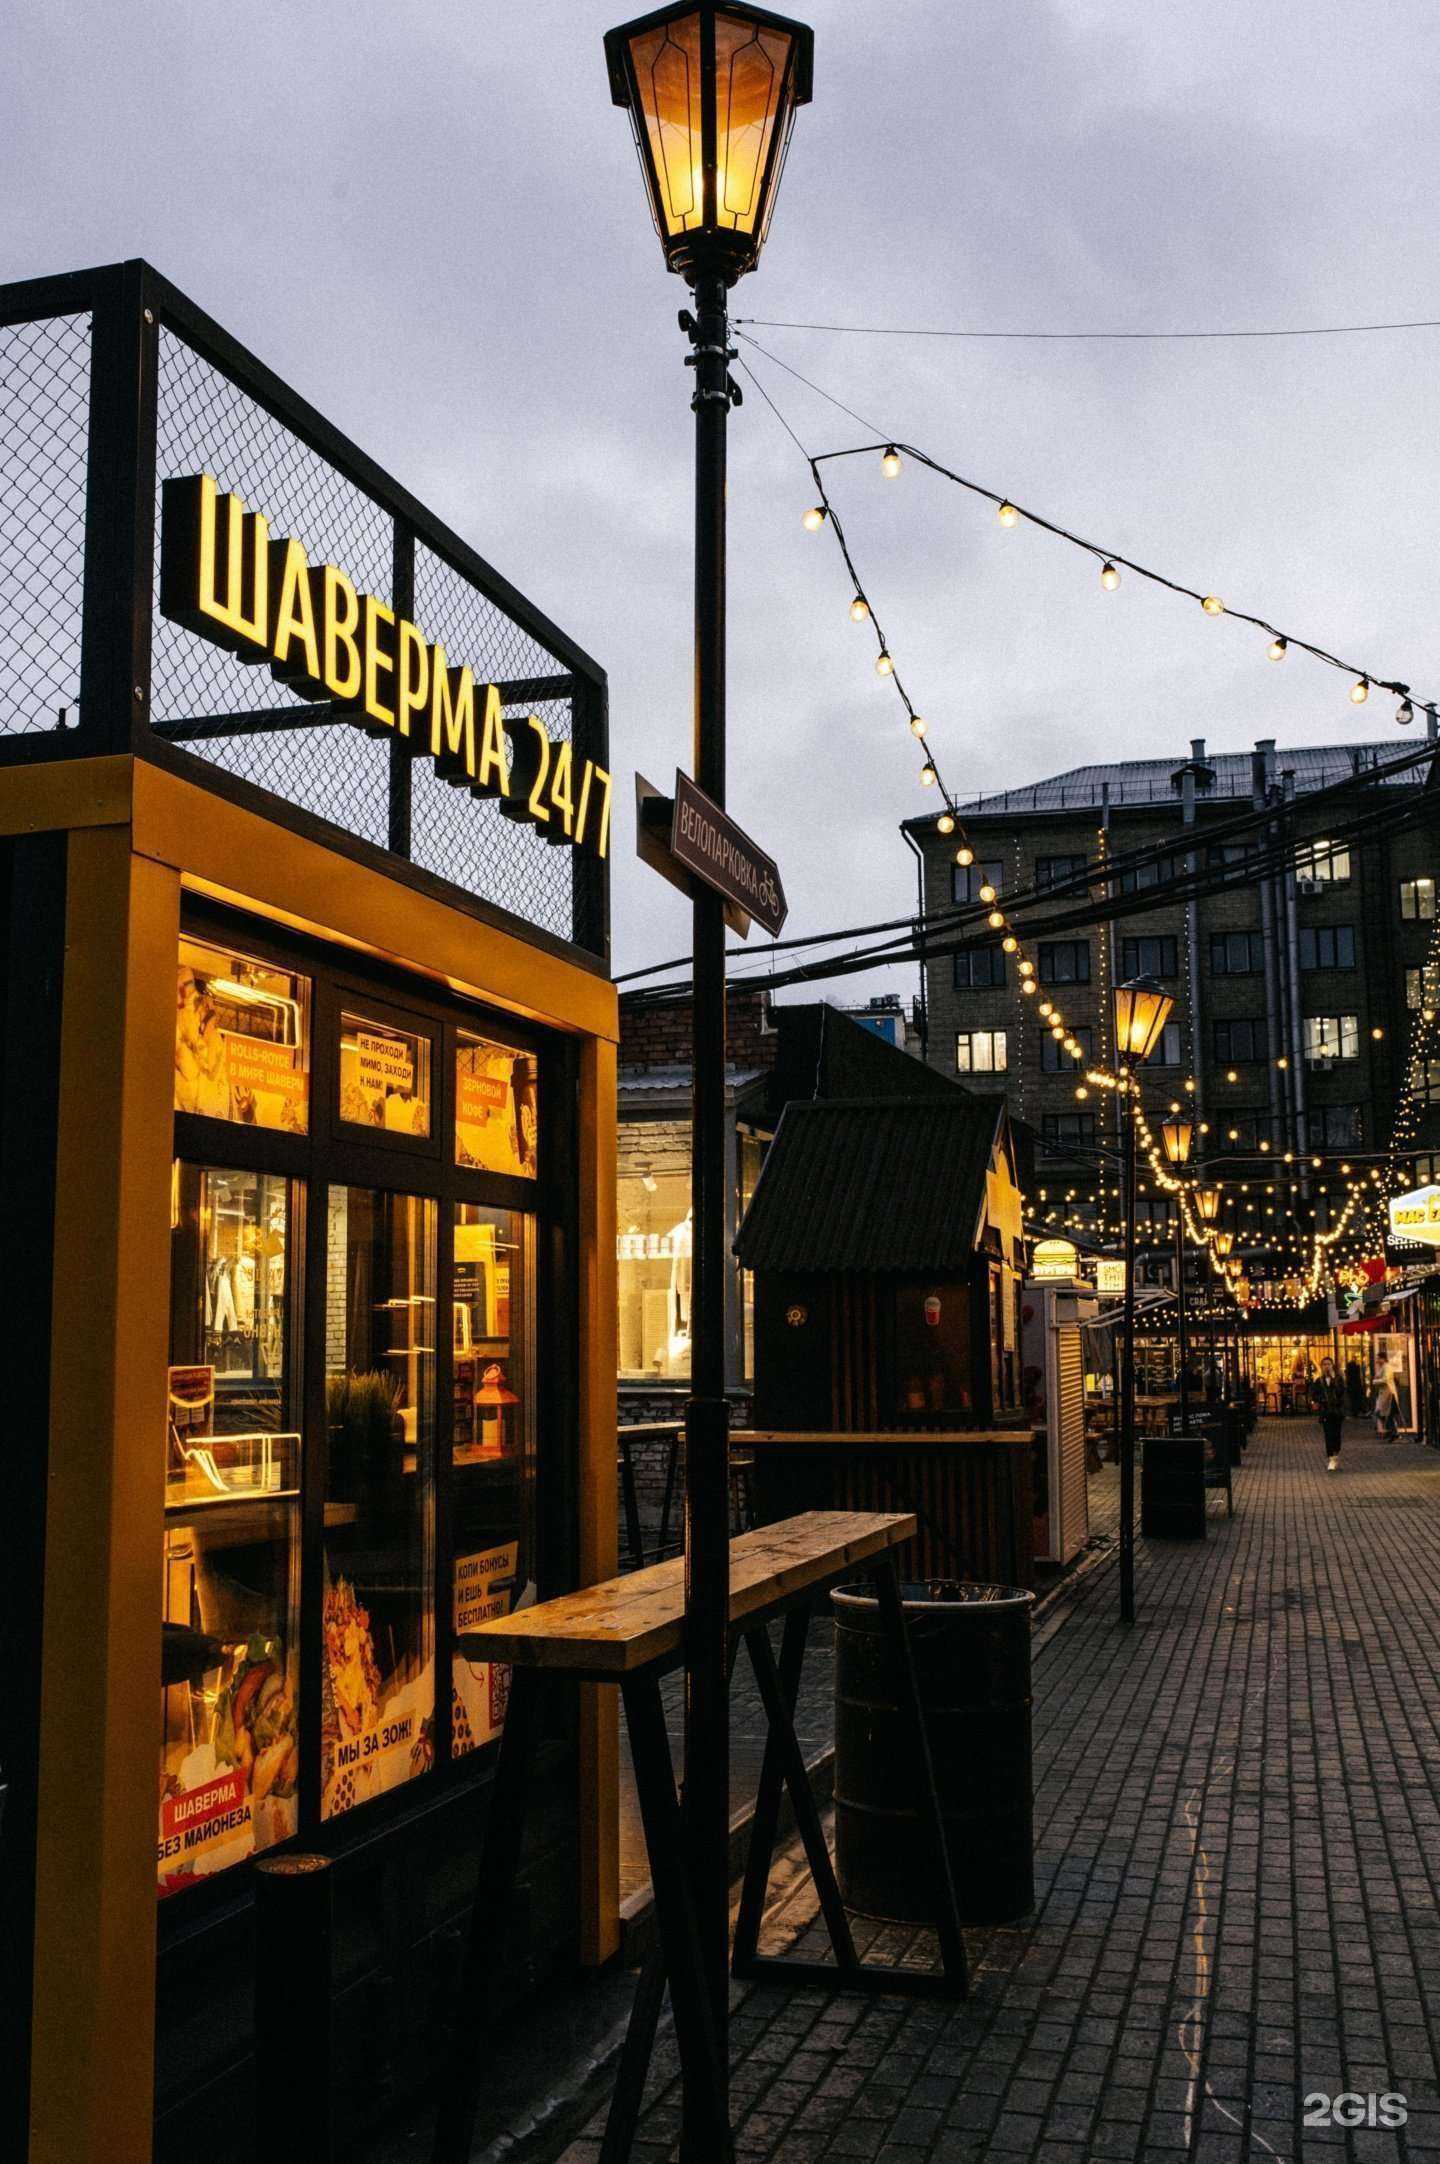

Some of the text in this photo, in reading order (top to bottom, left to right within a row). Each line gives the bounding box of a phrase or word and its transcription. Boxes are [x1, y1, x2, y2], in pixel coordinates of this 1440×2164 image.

[198, 473, 612, 859] ШАВЕРМА 24/7
[680, 801, 759, 898] ВЕЛОПАРКОВКА
[360, 1038, 404, 1061] НЕ ПРОХОДИ
[239, 1062, 266, 1083] МИРЕ
[360, 1056, 412, 1081] МИМО, ЗАХОДИ
[463, 1076, 502, 1099] ЗЕРНОВОЙ
[462, 1101, 484, 1119] КОФЕ
[457, 1552, 509, 1580] КОПИ БОНУСЫ
[457, 1584, 482, 1604] И ЕШЬ
[457, 1600, 504, 1628] БЕСПЛАТНО!
[338, 1718, 412, 1767] МЫ ЗА ЗОЖ!
[174, 1782, 237, 1823] ШАВЕРМА
[156, 1805, 252, 1860] БЕЗ МАЙОНЕЗА
